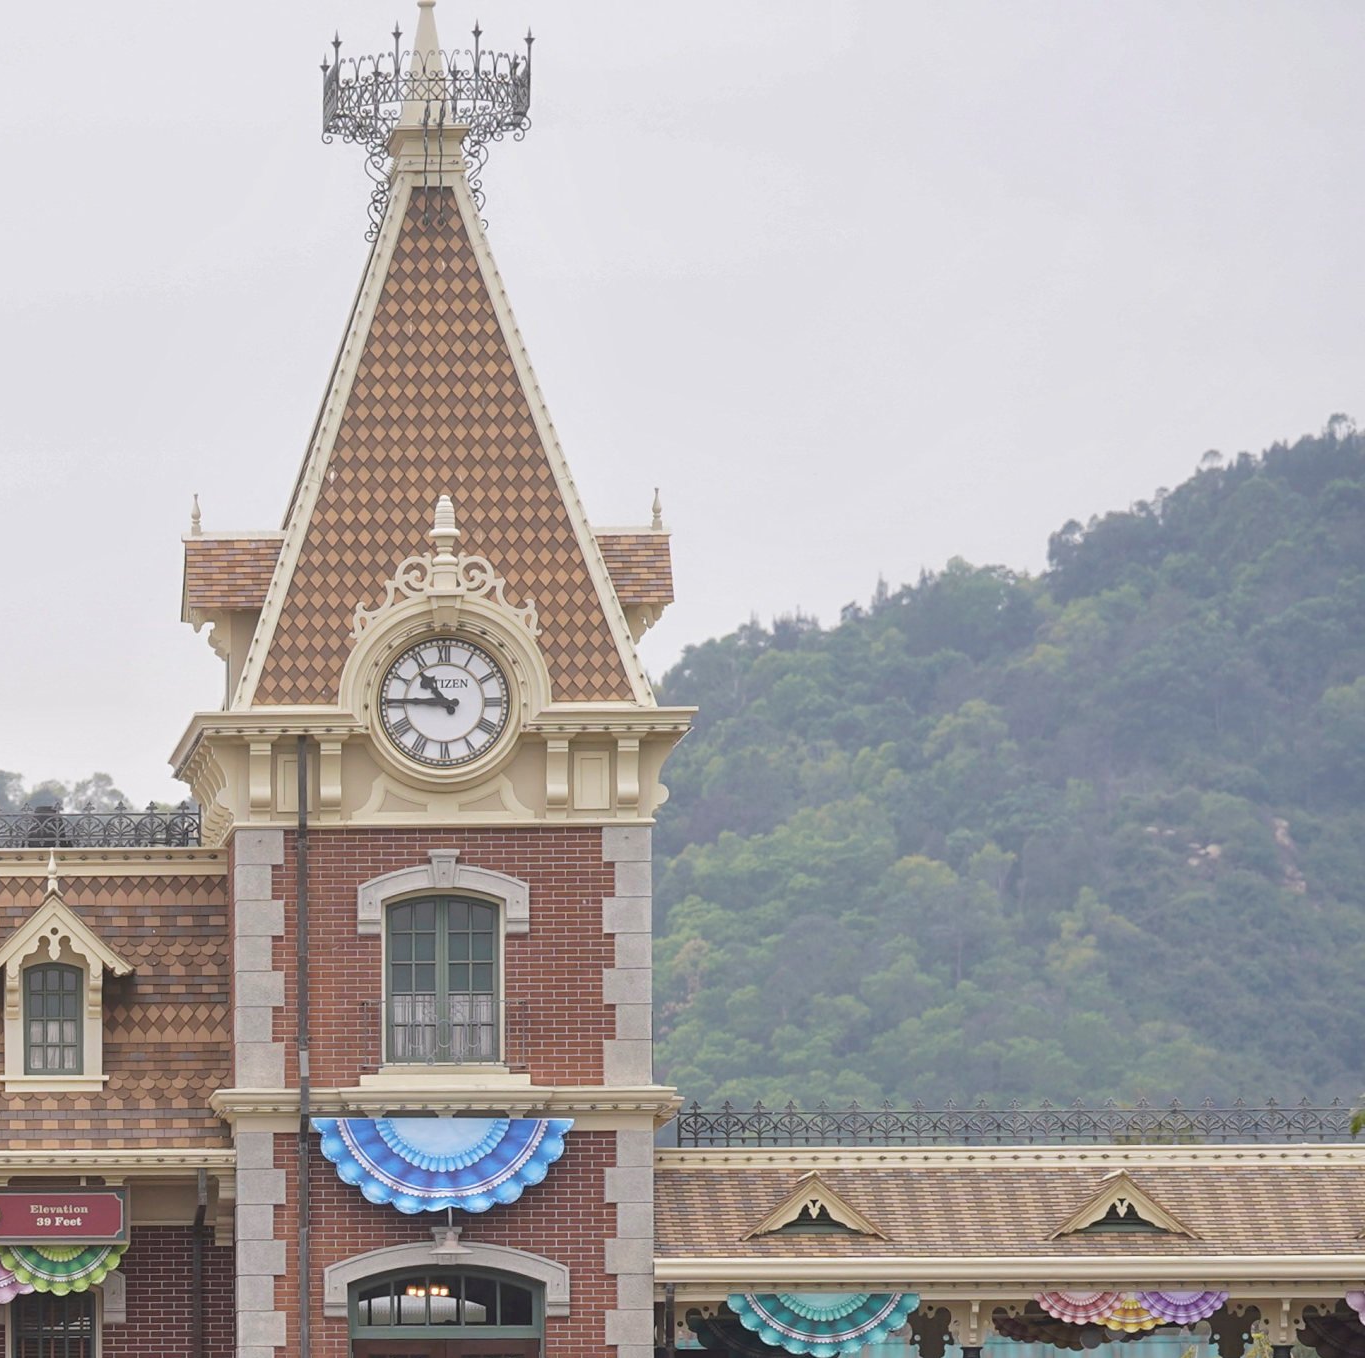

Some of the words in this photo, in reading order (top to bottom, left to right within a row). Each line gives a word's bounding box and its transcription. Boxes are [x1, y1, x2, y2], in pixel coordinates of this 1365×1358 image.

[437, 646, 451, 663] XII
[484, 697, 502, 707] III
[29, 1204, 89, 1214] Elevation
[36, 1217, 52, 1226] 39
[54, 1216, 82, 1226] Feet
